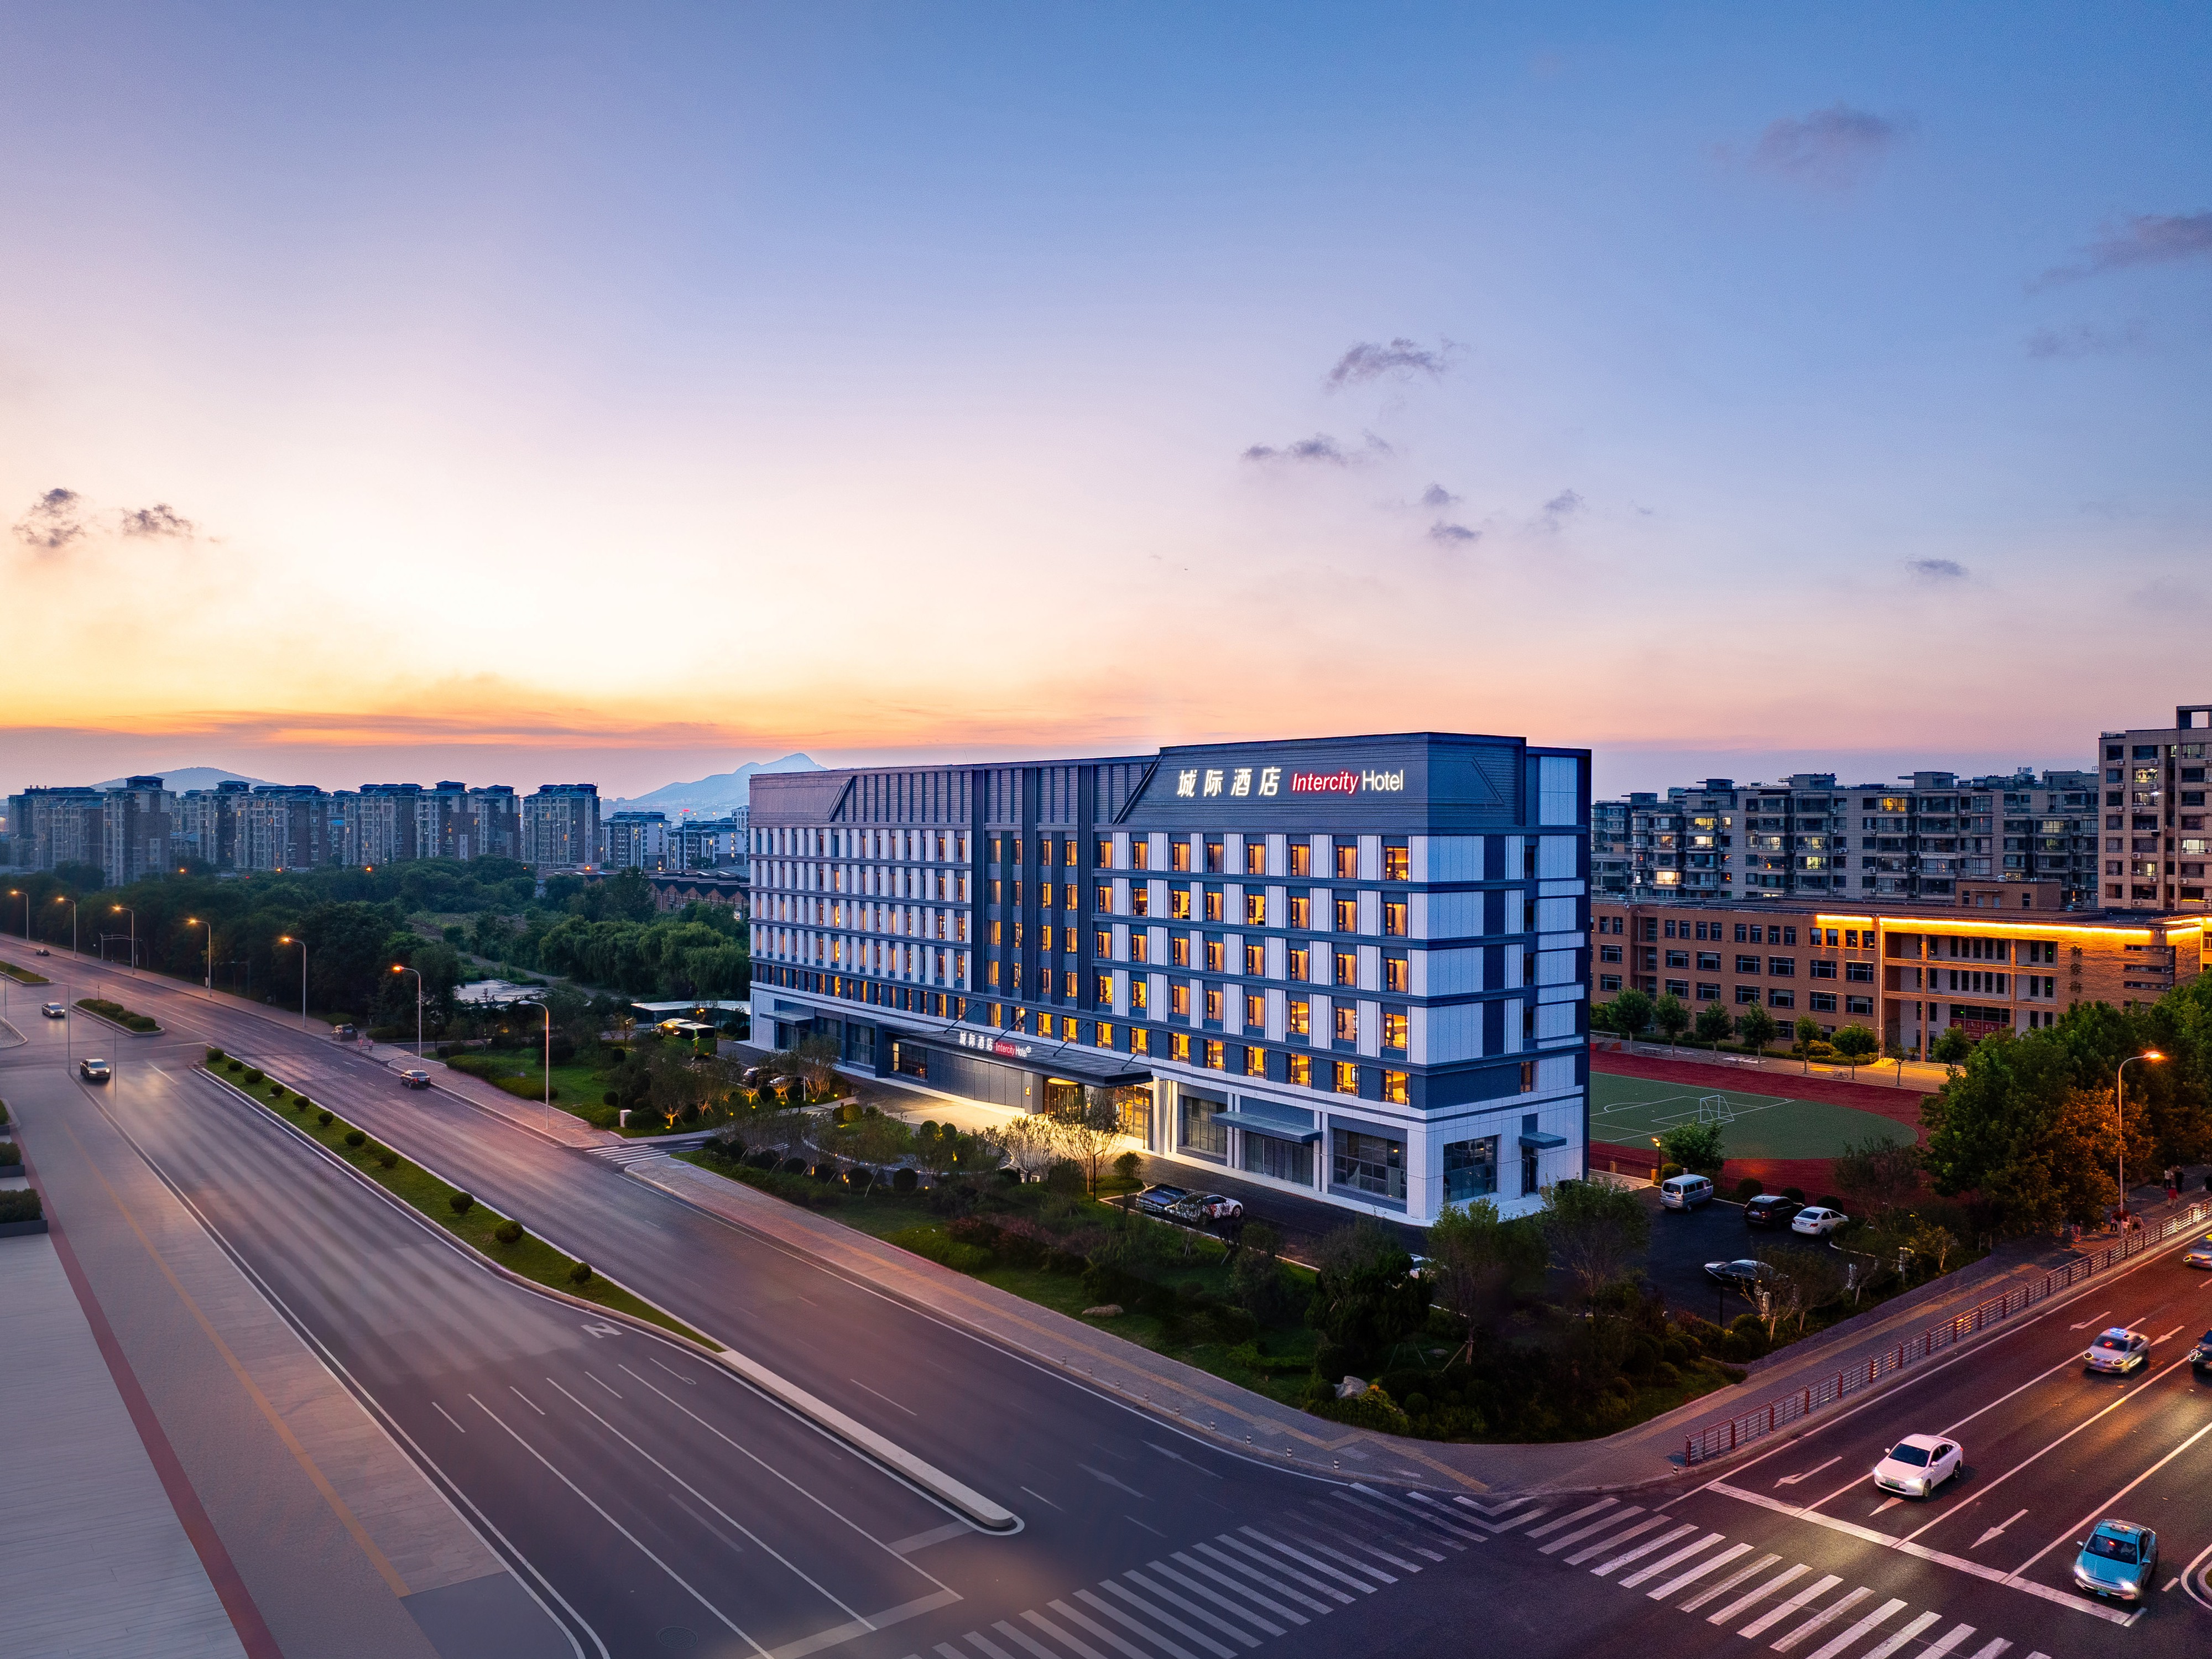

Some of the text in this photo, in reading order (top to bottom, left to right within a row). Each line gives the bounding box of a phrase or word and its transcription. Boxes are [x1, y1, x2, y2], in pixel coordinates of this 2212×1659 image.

[1177, 767, 1281, 797] 城际酒店
[1292, 769, 1404, 794] Intercity Hotel
[959, 1031, 993, 1051] 城际酒店
[996, 1042, 1015, 1055] Intercity
